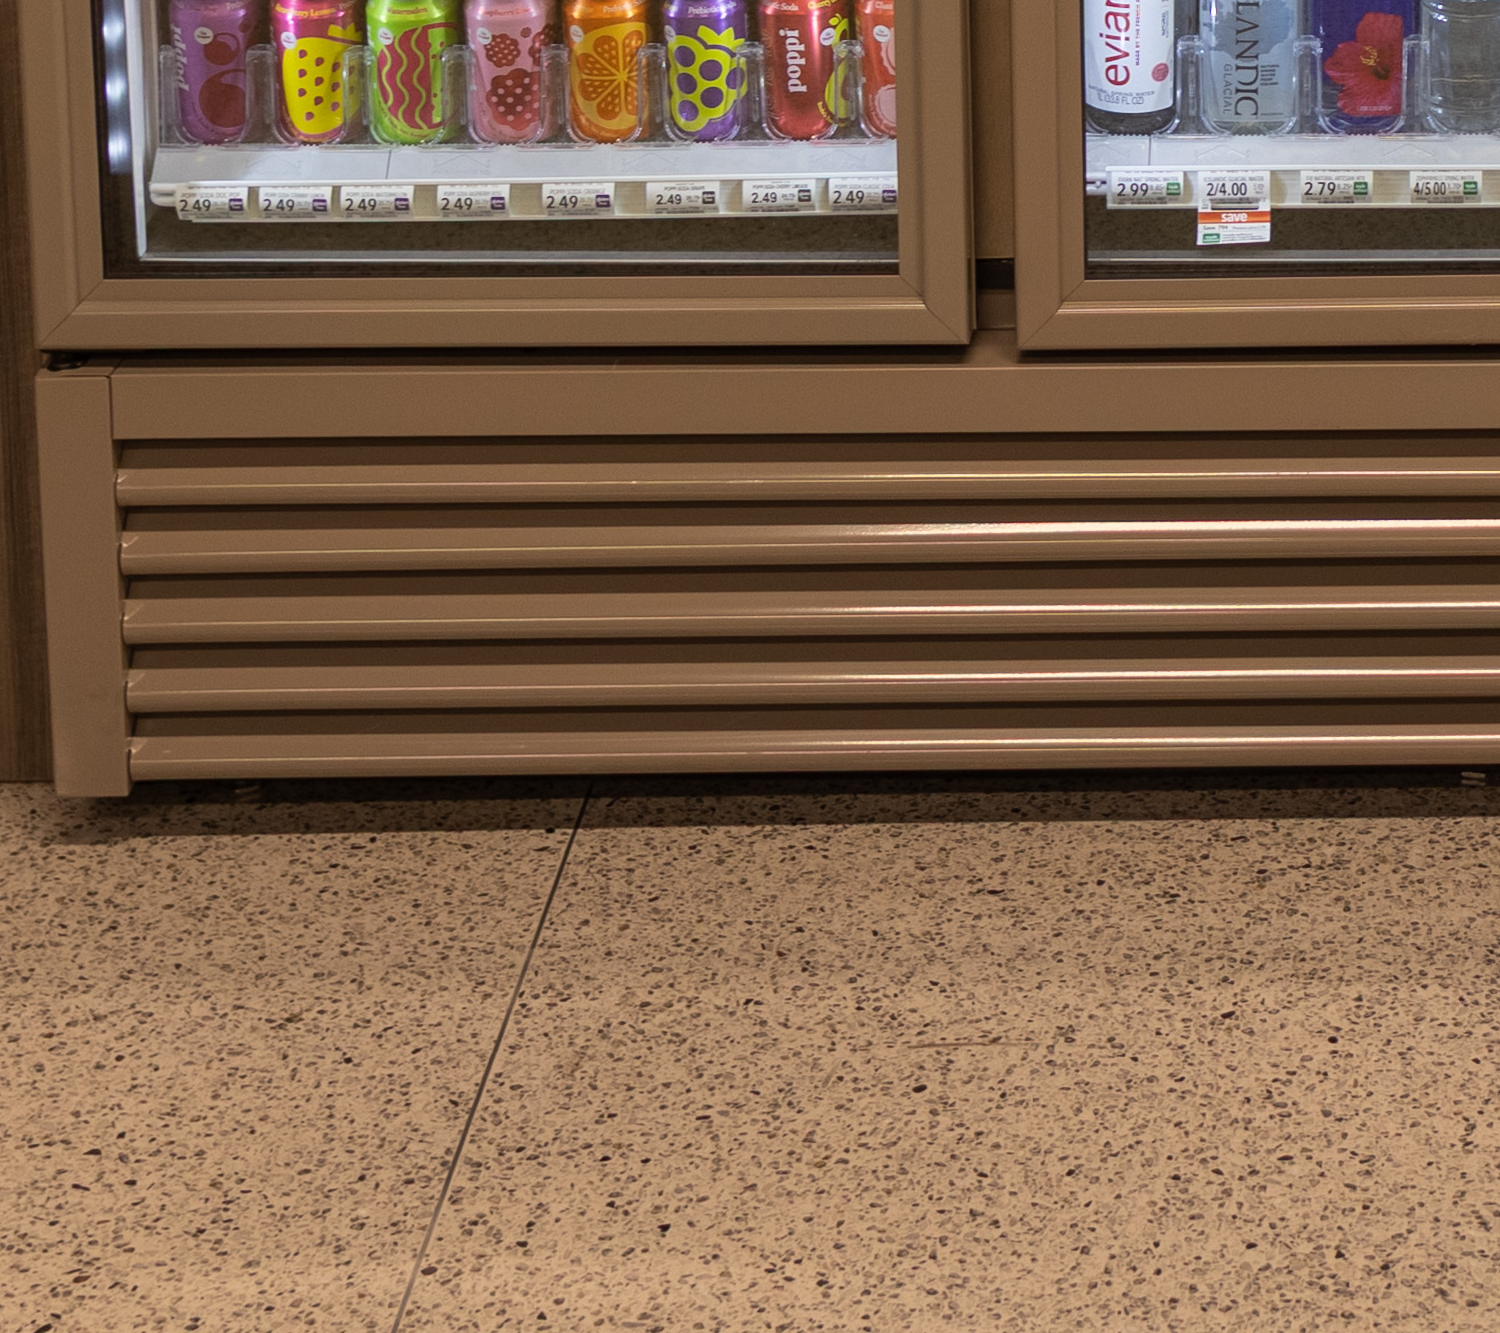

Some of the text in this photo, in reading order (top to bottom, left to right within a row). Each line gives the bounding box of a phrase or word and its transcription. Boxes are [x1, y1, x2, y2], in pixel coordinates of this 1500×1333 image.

[784, 28, 805, 93] poppi
[1304, 182, 1335, 196] 2.79
[547, 196, 577, 208] 2.49
[833, 191, 864, 203] 2.49
[345, 198, 377, 211] 2.49
[1221, 212, 1247, 222] save
